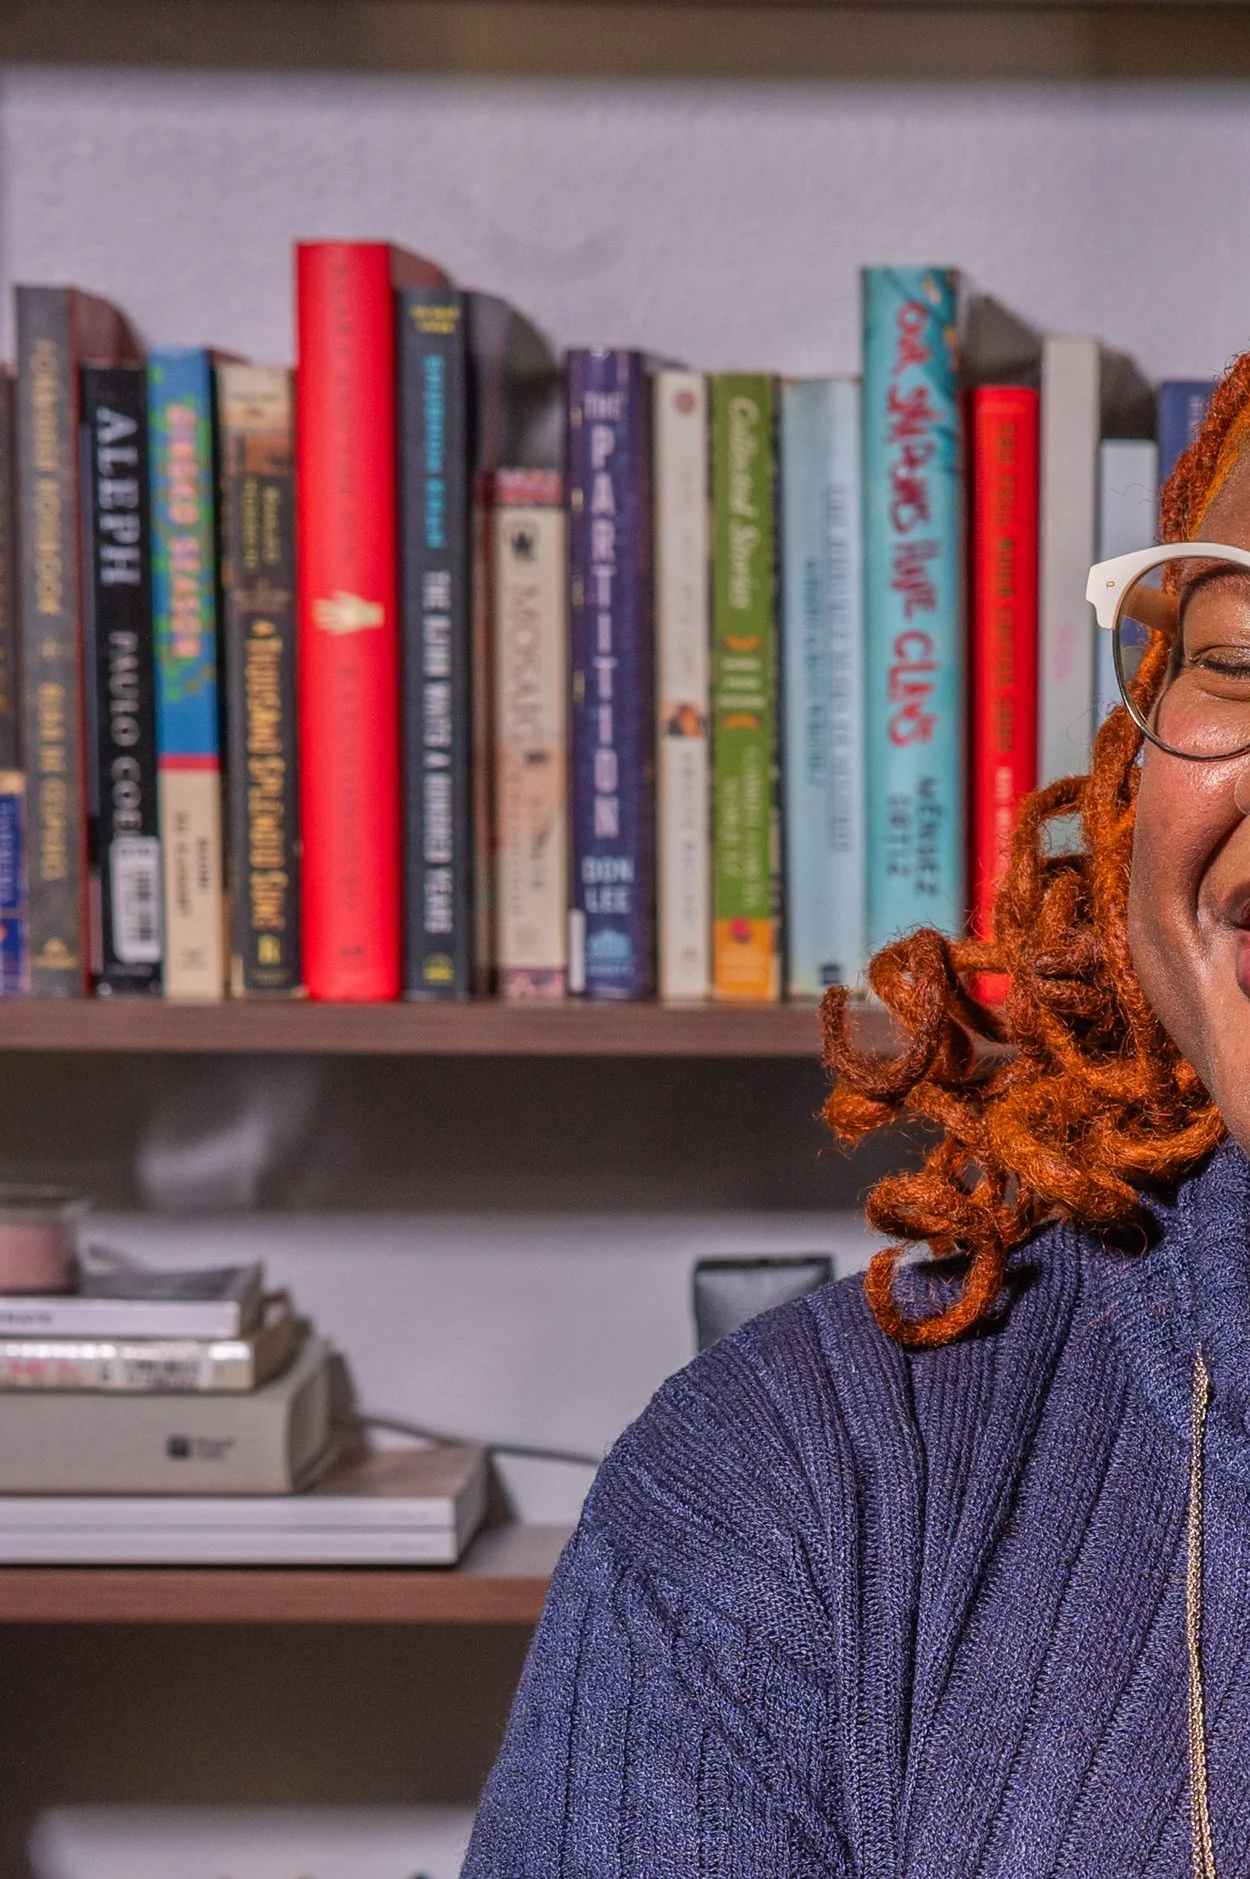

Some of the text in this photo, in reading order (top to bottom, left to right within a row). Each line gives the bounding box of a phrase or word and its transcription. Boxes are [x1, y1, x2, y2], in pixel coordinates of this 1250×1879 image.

[97, 405, 140, 586] ALEPH
[423, 571, 451, 609] THE
[588, 424, 620, 840] PARTITION
[108, 629, 139, 747] PAULO
[888, 630, 941, 747] CLAWS
[582, 856, 634, 884] DON
[585, 885, 632, 914] LEE
